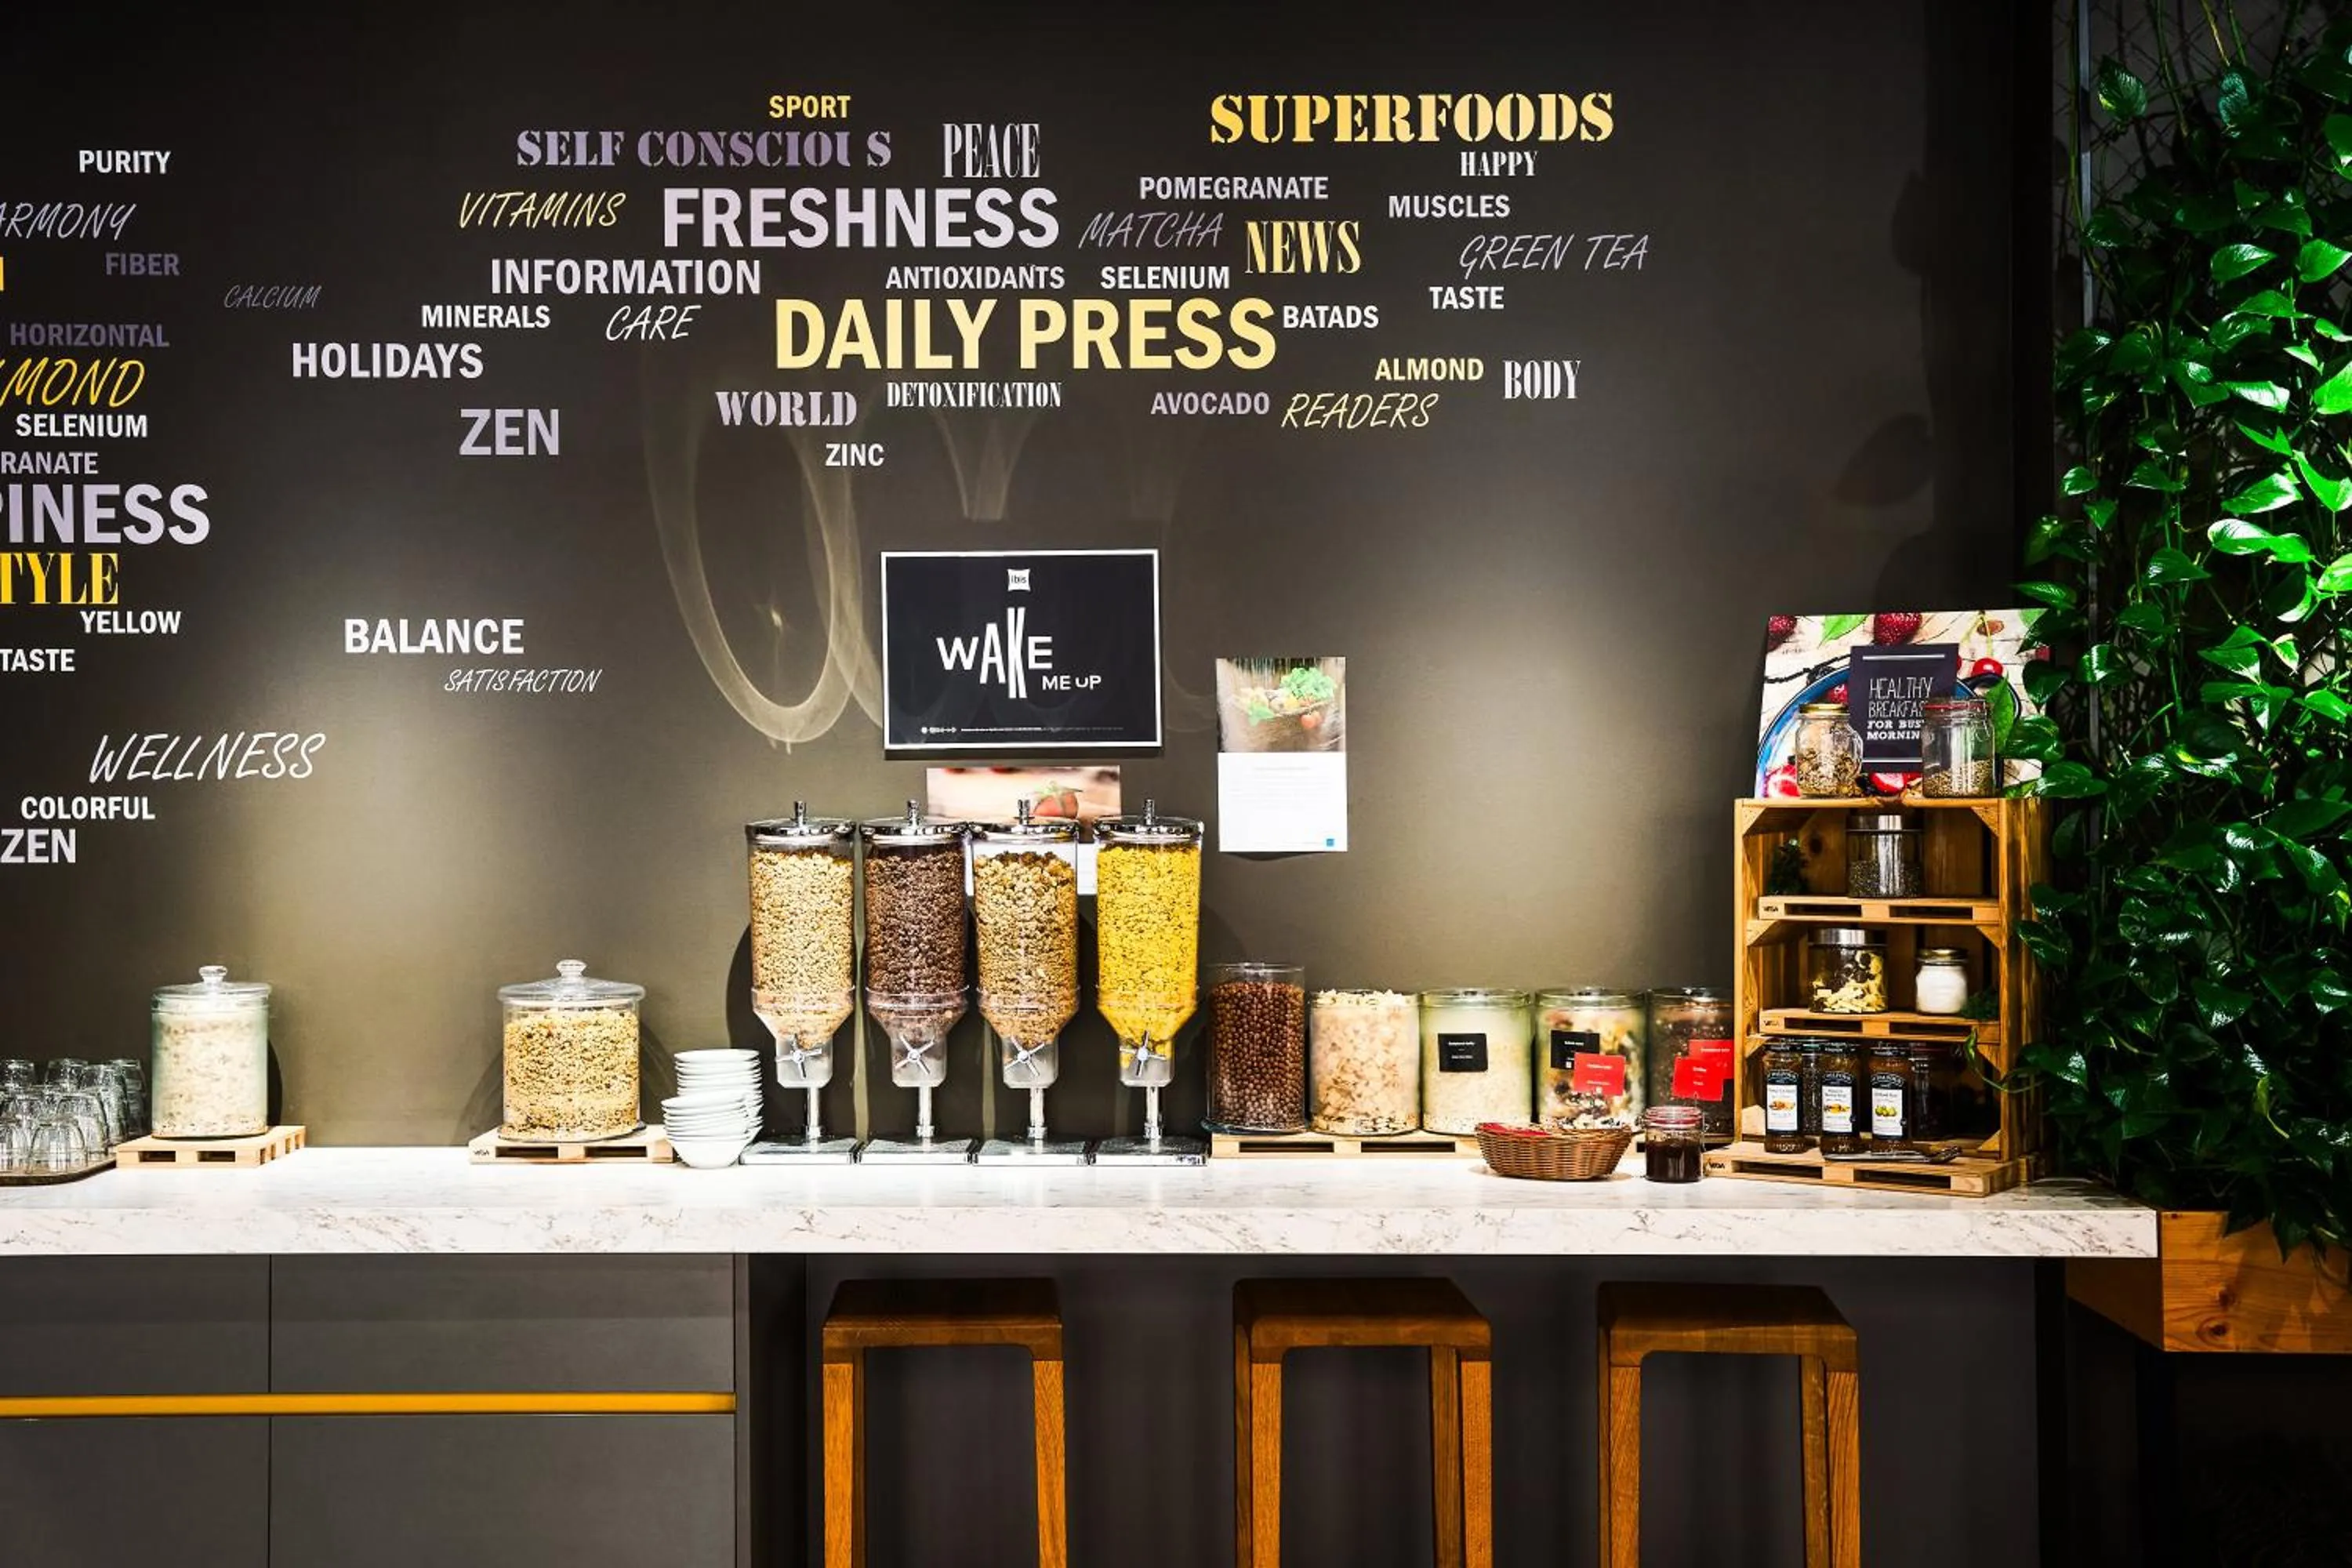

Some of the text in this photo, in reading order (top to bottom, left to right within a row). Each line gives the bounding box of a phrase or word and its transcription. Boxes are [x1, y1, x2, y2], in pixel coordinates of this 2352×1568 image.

[770, 96, 851, 118] SPORT
[1211, 93, 1613, 143] SUPERFOODS
[517, 130, 624, 165] SELF
[943, 124, 1039, 177] PEACE
[80, 151, 170, 174] PURITY
[1461, 151, 1537, 176] HAPPY
[1141, 177, 1328, 199] POMEGRANATE
[460, 192, 626, 228] VITAMINS
[665, 188, 1058, 248] FRESHNESS
[1389, 194, 1510, 218] MUSCLES
[0, 202, 136, 240] RMONY
[1079, 211, 1223, 249] MATCHA
[1245, 221, 1360, 273] NEWS
[1460, 234, 1648, 279] GREEN TEA
[106, 253, 180, 275] FIBER
[492, 259, 760, 295] INFORMATION
[886, 266, 1065, 289] ANTIOXIDANTS
[1101, 267, 1229, 289] SELENIUM
[224, 285, 321, 308] CALCIUM
[1429, 287, 1504, 309] TASTE
[422, 305, 550, 328] MINERALS
[606, 305, 701, 340] CARE
[1283, 306, 1378, 328] BATADS
[11, 324, 169, 347] HORIZONTAL
[776, 298, 1276, 369] DAILY PRESS
[293, 343, 483, 378] HOLIDAYS
[1375, 358, 1483, 380] ALMOND
[0, 358, 144, 407] MOND
[1504, 361, 1581, 398] BODY
[887, 383, 1061, 407] DETOXIFICATION
[1151, 392, 1269, 414] AVOCADO
[715, 391, 856, 426] WORLD
[1281, 393, 1439, 429] READERS
[16, 414, 147, 437] SELENIUM
[459, 409, 558, 455] ZEN
[2, 452, 98, 474] RANATE
[826, 444, 884, 466] ZINC
[0, 485, 209, 544] INESS
[80, 611, 181, 633] YELLOW
[345, 619, 524, 654] BALANCE
[0, 649, 74, 671] TASTE
[936, 607, 1053, 699] WAKE
[444, 669, 602, 692] SATISFACTION
[1042, 674, 1102, 691] ME UP
[1868, 677, 1933, 699] HEALTHY
[1868, 701, 1927, 718] BREAKFAS
[1867, 719, 1925, 730] FOR BUS
[1867, 730, 1920, 741] MORNIN
[89, 731, 325, 784] WELLNESS
[21, 797, 155, 819] COLORFUL
[0, 829, 75, 862] ZEN
